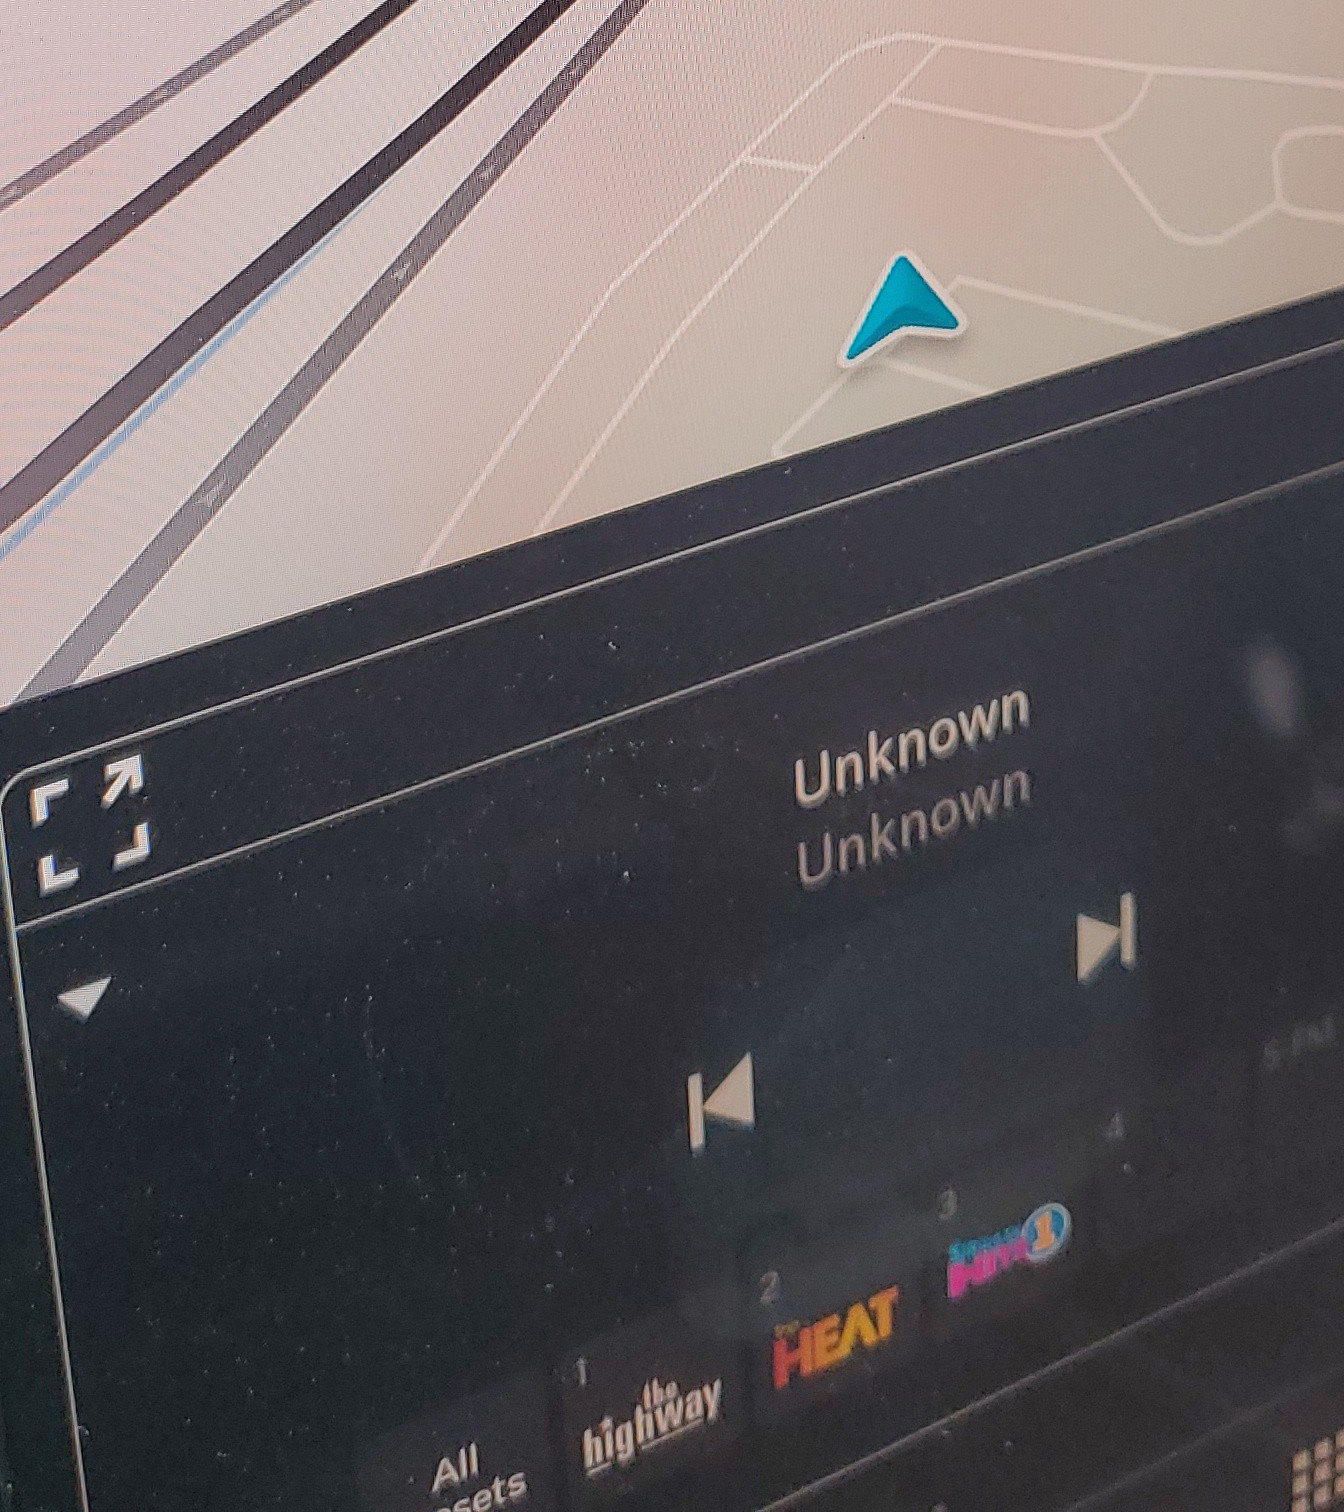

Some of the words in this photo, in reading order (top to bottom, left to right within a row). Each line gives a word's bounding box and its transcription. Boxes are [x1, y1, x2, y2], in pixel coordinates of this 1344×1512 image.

[795, 689, 1030, 809] Unknown
[798, 769, 1031, 890] Unknown
[759, 1270, 780, 1305] 2
[576, 1356, 587, 1387] 1
[772, 1284, 900, 1390] HEAT
[582, 1377, 723, 1470] highway
[642, 1377, 680, 1410] the
[432, 1441, 479, 1494] All
